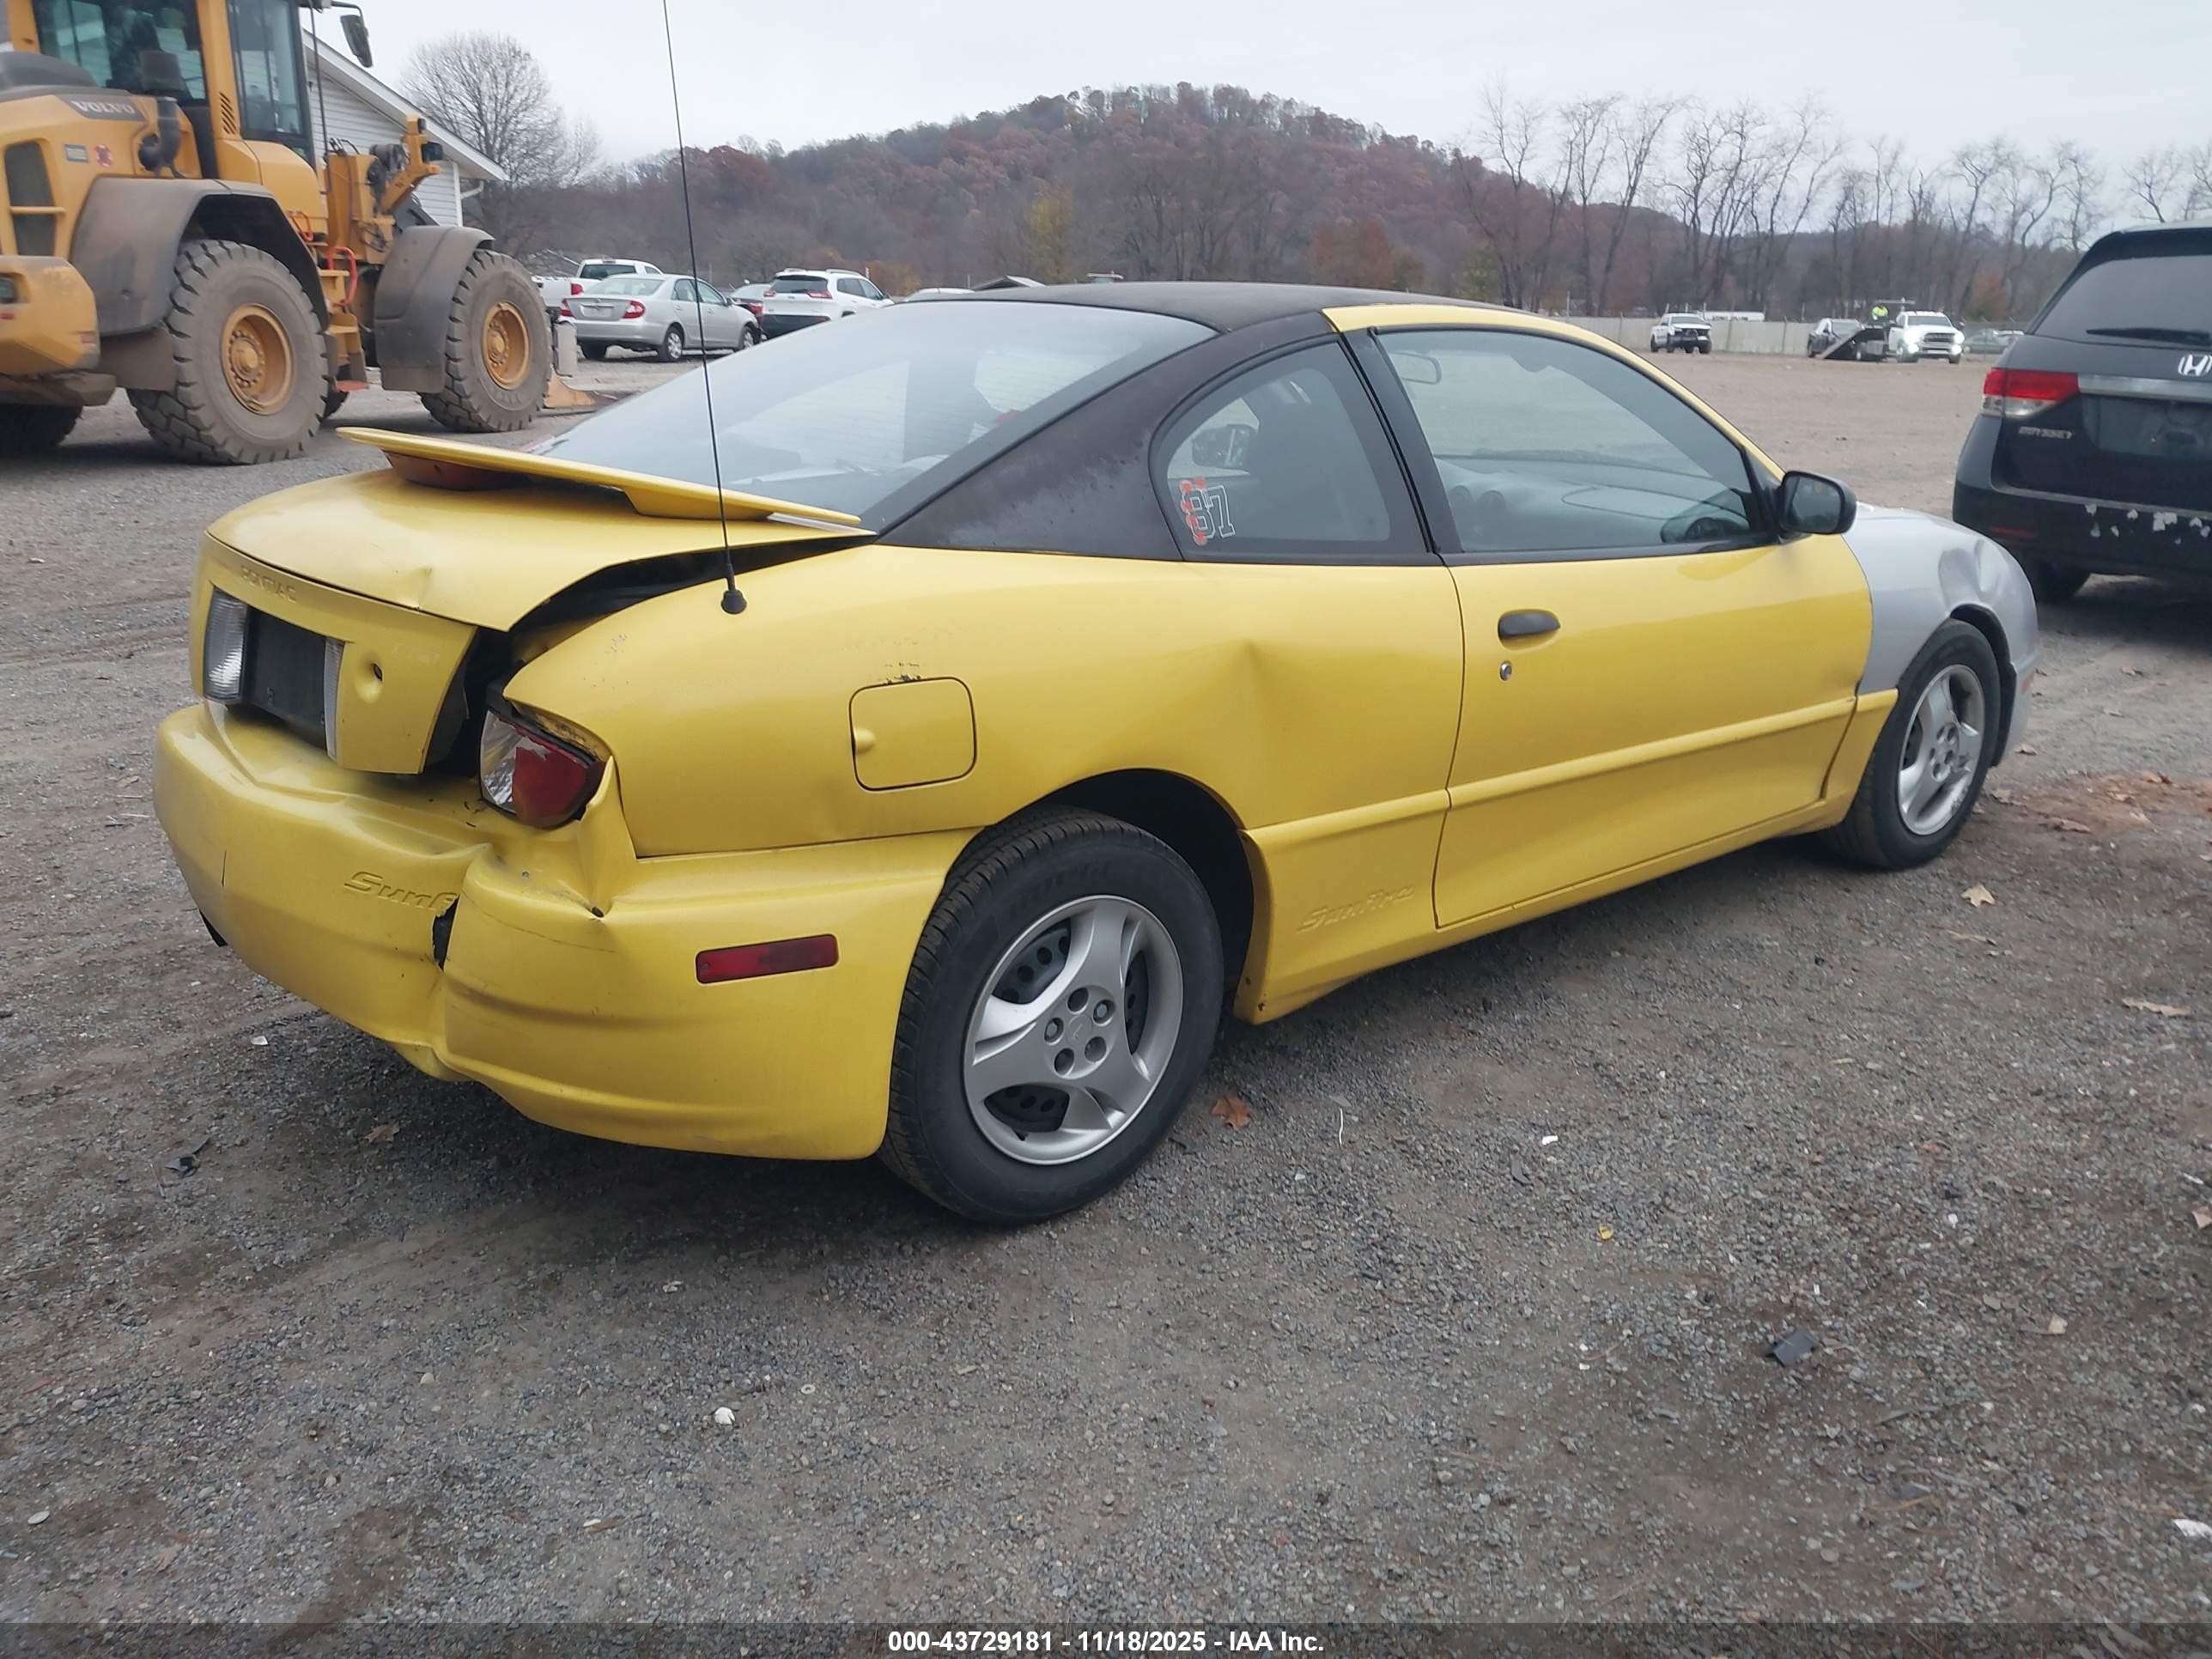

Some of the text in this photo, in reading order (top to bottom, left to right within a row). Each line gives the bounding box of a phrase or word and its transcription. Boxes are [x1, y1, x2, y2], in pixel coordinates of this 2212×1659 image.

[70, 100, 136, 114] VOLVO
[1181, 482, 1237, 541] 87
[343, 871, 460, 911] Sunf
